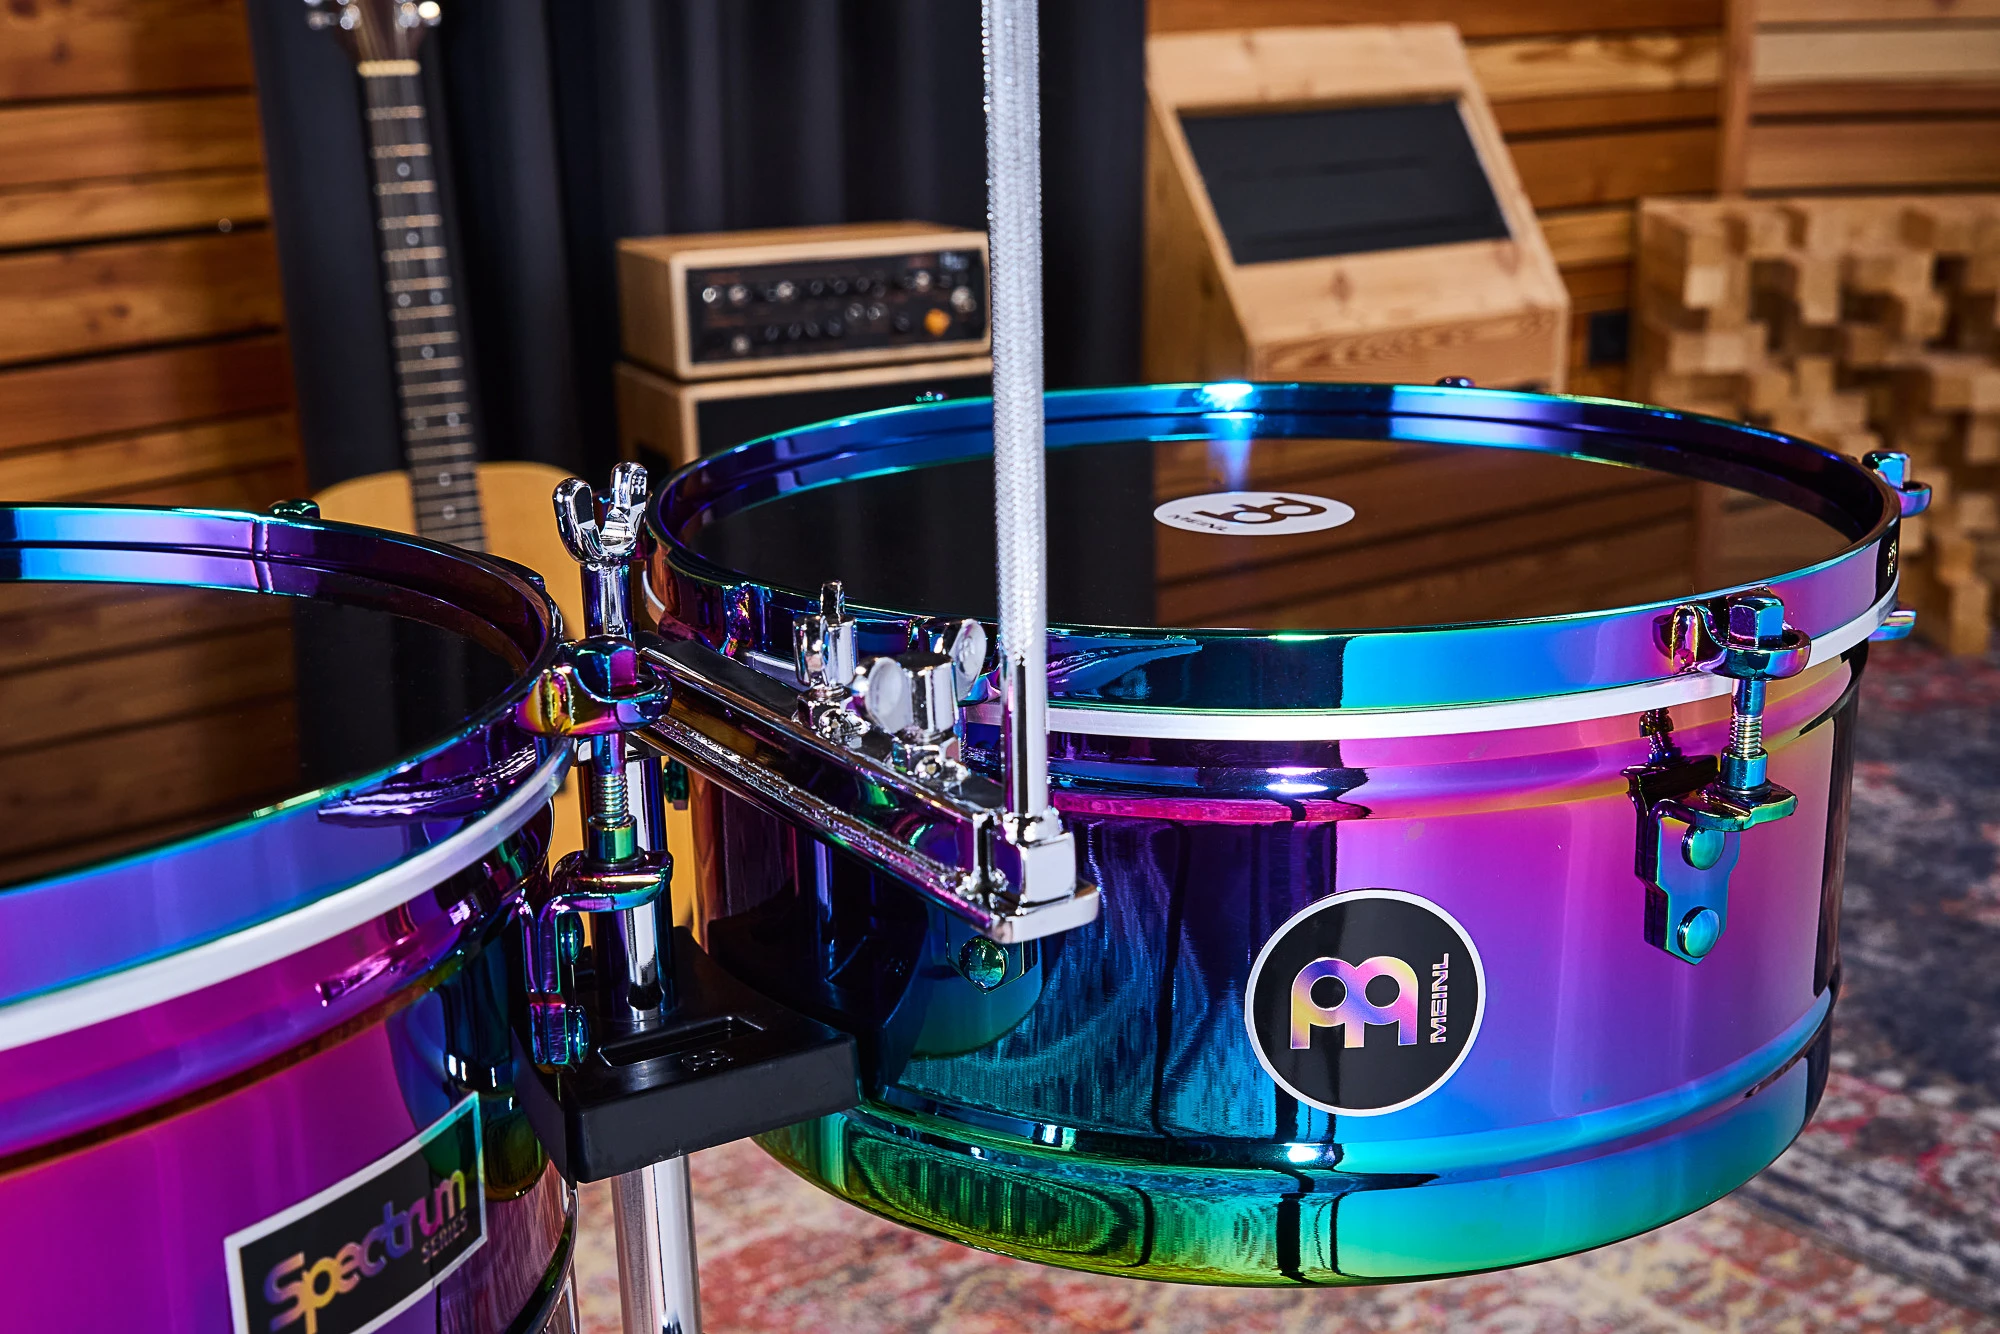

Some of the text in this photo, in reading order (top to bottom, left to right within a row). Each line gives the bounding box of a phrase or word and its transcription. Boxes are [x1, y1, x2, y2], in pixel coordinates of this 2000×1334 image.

[1429, 952, 1449, 1044] MEINL
[263, 1169, 467, 1334] Spectrum
[421, 1208, 469, 1265] SERIES
